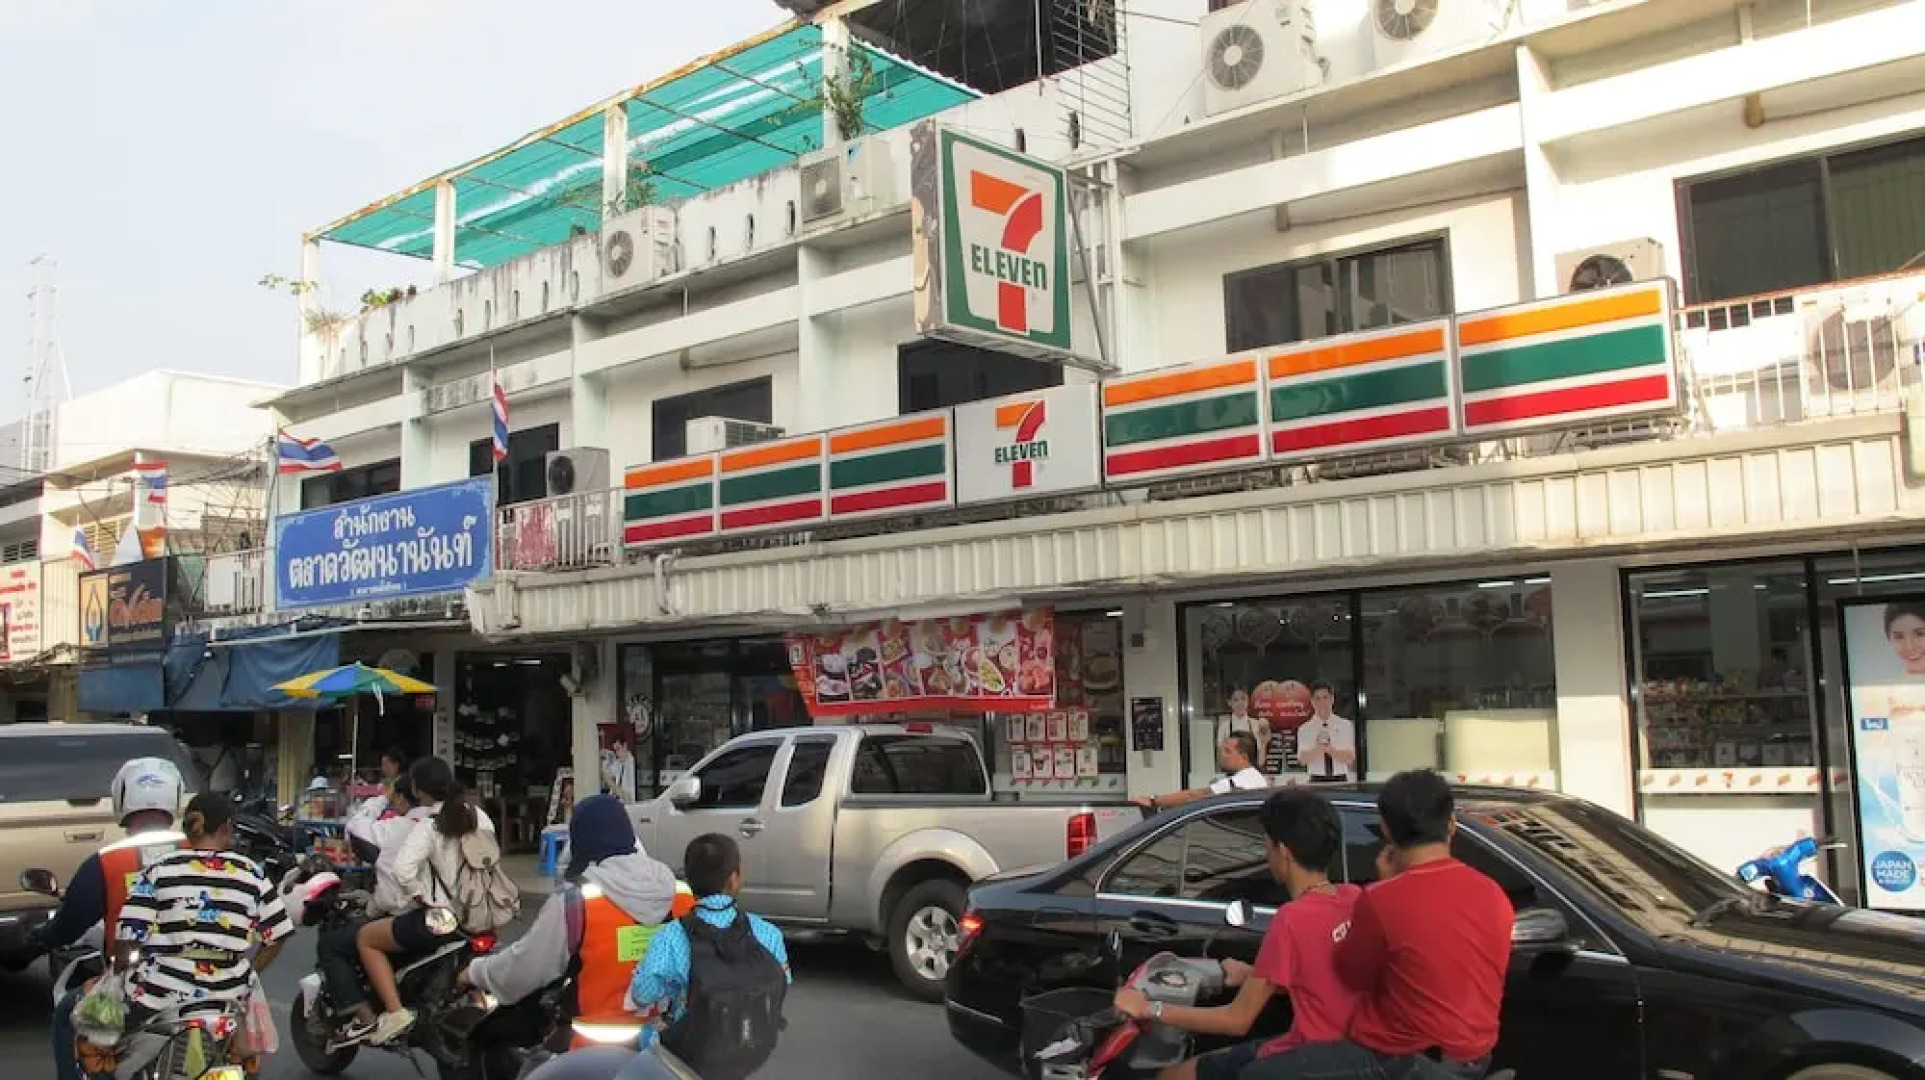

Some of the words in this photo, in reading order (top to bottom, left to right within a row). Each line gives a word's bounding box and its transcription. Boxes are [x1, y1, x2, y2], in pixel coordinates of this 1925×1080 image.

[971, 169, 1043, 333] 7
[995, 400, 1046, 489] 7
[334, 504, 416, 540] สำนักงาน
